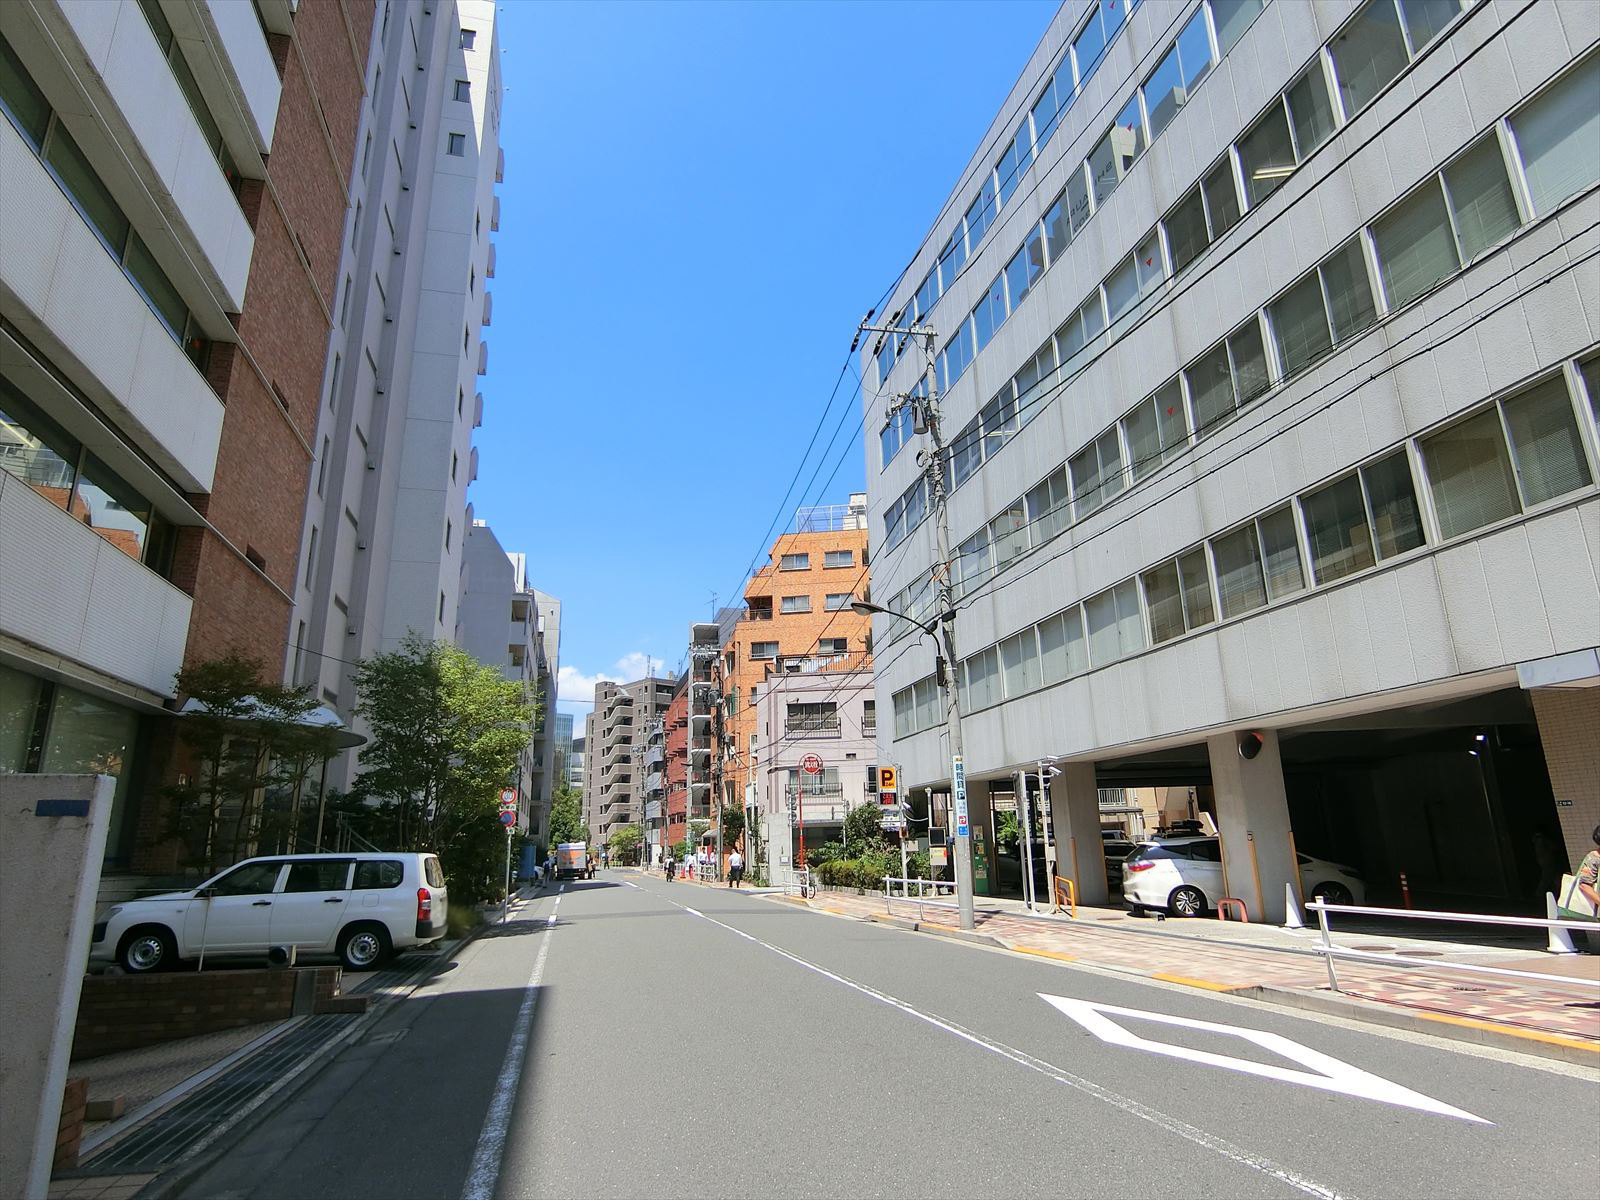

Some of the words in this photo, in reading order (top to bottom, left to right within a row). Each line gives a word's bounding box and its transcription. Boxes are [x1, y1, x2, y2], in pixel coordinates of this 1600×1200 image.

[881, 770, 894, 787] P
[955, 763, 964, 789] 時間貸
[958, 791, 965, 800] P
